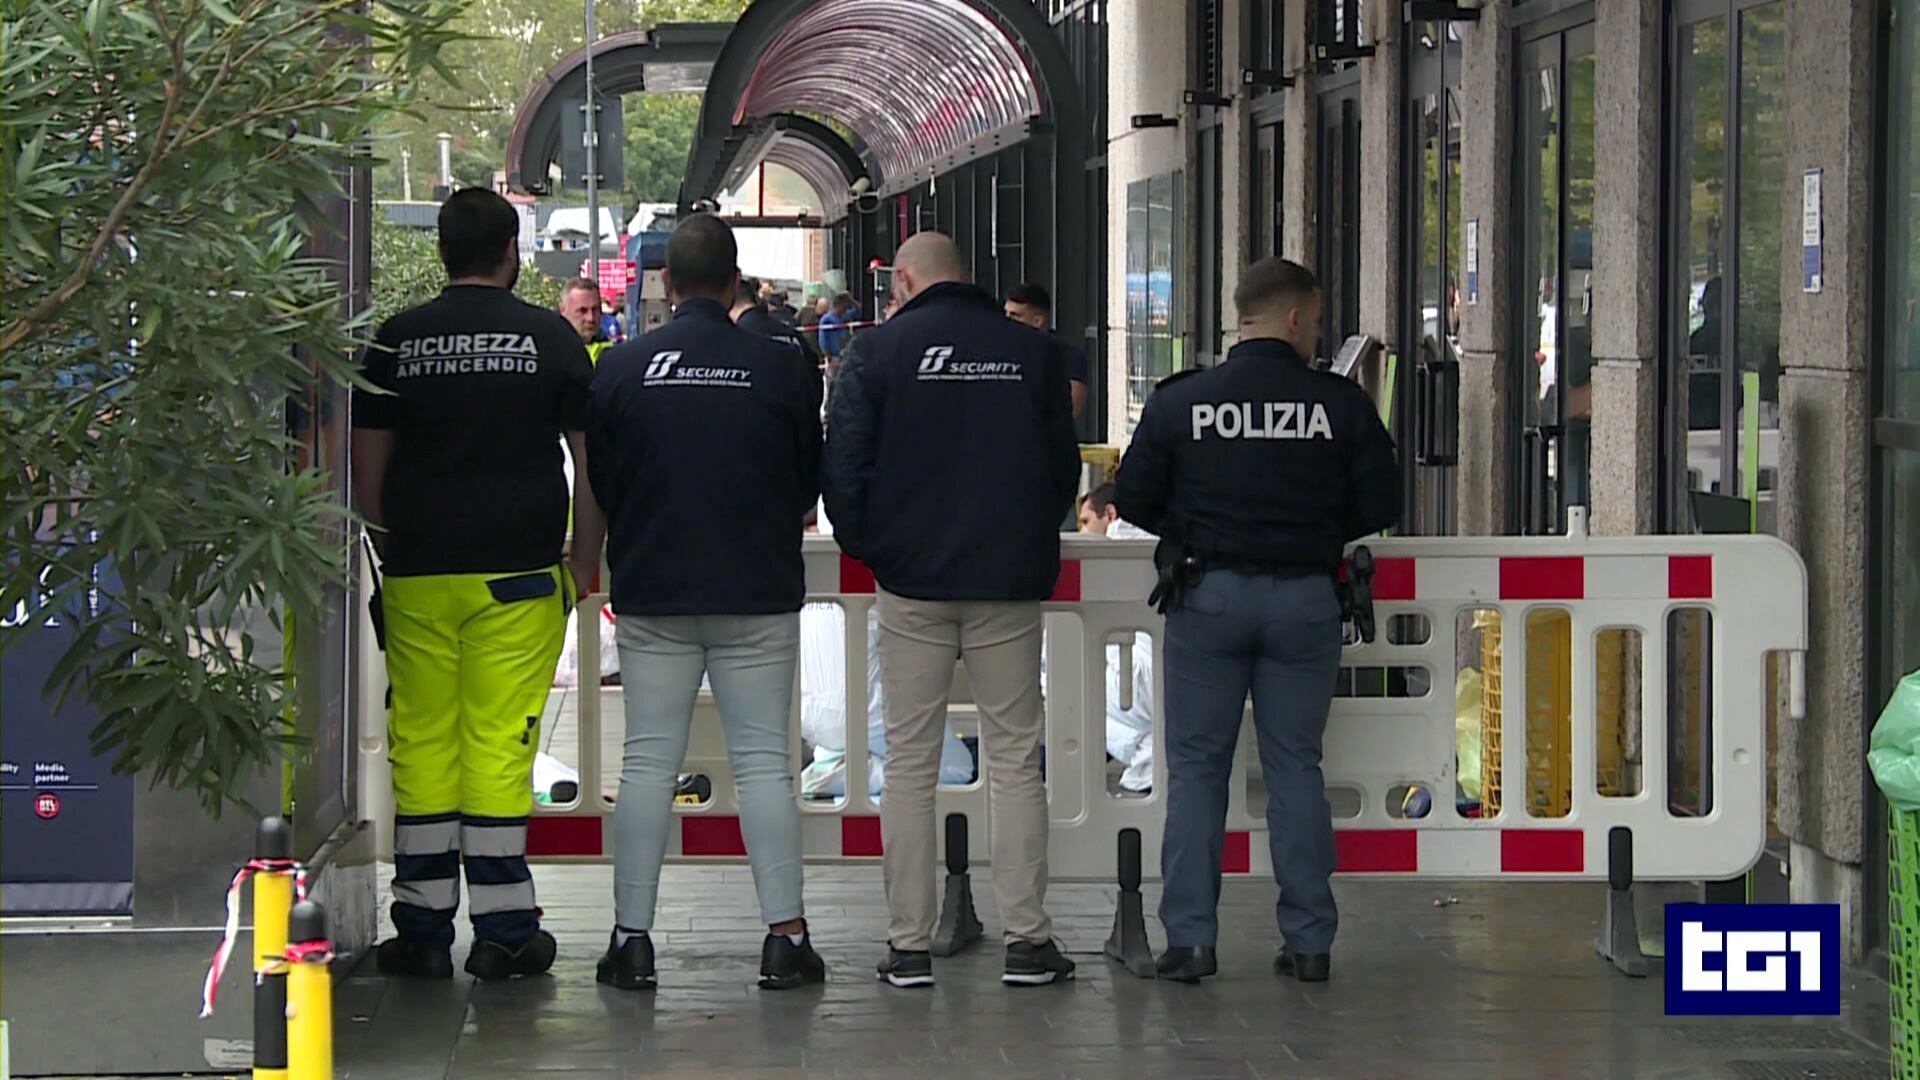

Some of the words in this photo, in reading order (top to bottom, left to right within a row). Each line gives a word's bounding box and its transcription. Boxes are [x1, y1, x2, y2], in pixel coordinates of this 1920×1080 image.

[399, 333, 538, 359] SICUREZZA
[396, 358, 538, 379] ANTINCENDIO
[676, 367, 751, 380] SECURITY
[949, 362, 1021, 374] SECURITY
[1192, 402, 1333, 440] POLIZIA
[35, 763, 65, 772] Media
[35, 773, 70, 784] partner
